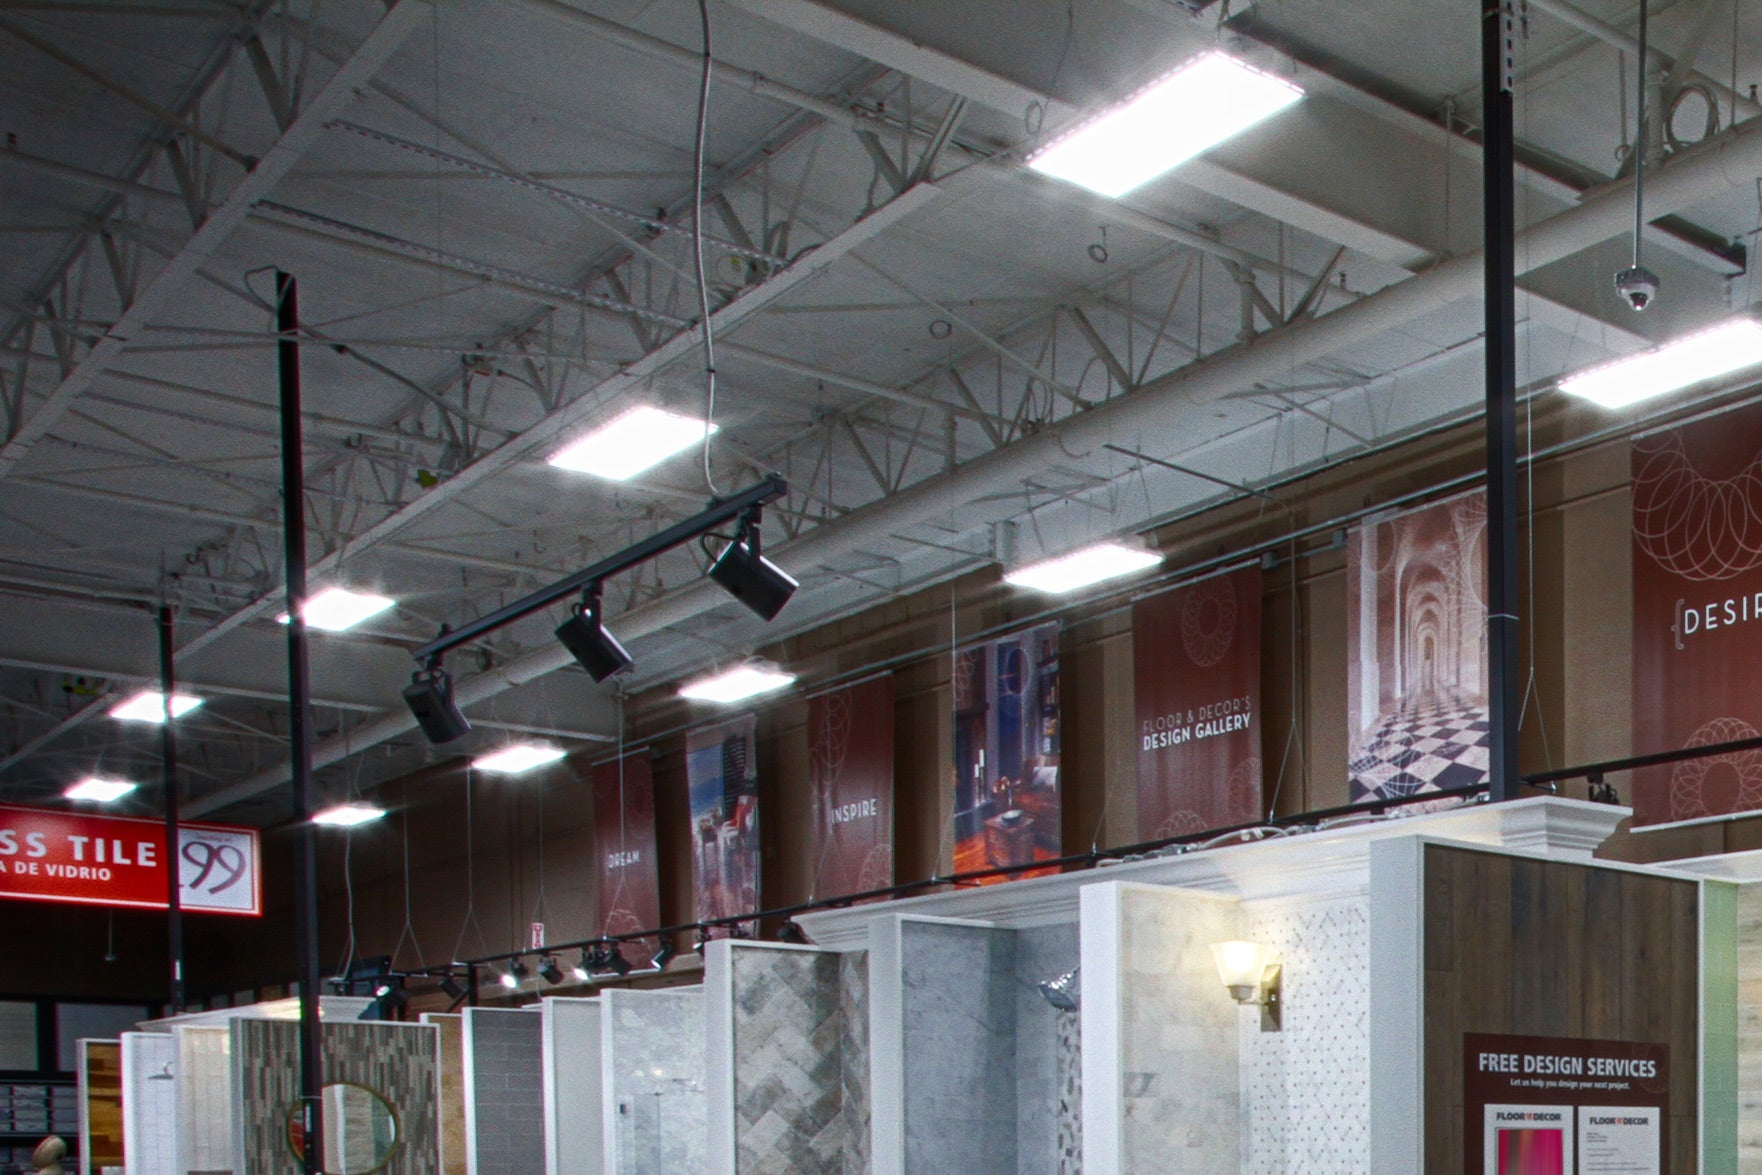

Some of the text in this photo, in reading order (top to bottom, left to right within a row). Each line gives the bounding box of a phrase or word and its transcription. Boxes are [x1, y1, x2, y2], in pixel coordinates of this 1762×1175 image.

[1143, 712, 1251, 751] DESIGN GALLERY
[832, 798, 877, 824] INSPIRE
[68, 835, 157, 867] TILE
[14, 861, 39, 876] DE
[45, 863, 111, 881] VIDRIO
[1479, 1053, 1656, 1078] FREE DESIGN SERVICES
